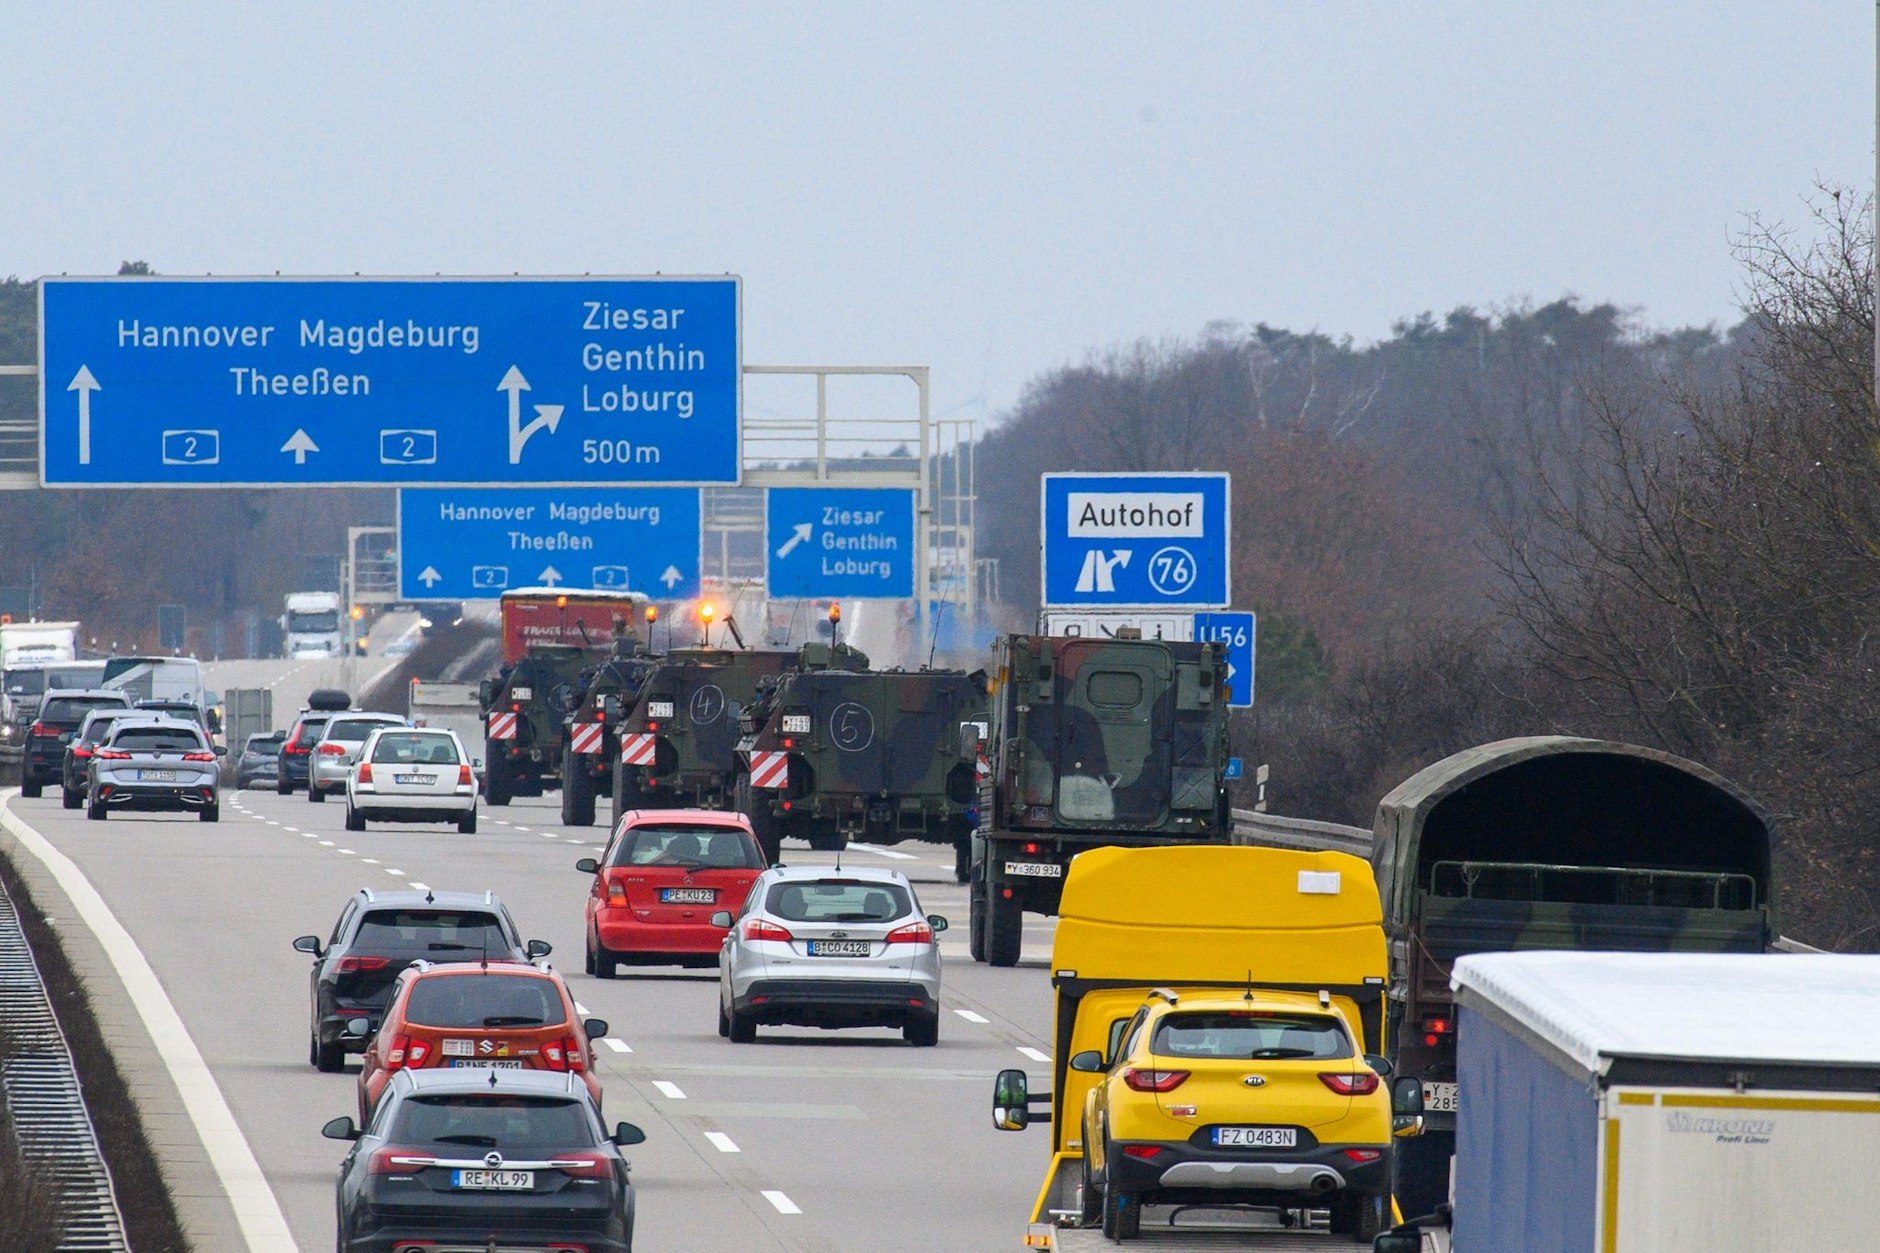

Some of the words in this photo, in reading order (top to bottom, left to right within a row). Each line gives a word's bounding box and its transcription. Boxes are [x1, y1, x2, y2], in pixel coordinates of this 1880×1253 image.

[583, 302, 684, 330] Ziesar
[118, 320, 274, 347] Hannover
[300, 320, 480, 354] Magdeburg
[583, 343, 704, 371] Genthin
[230, 367, 370, 395] Theeßen
[583, 385, 694, 418] Loburg
[184, 437, 197, 458] 2
[402, 437, 415, 458] 2
[440, 503, 534, 520] Hannover
[549, 503, 660, 525] Magdeburg
[822, 506, 884, 526] Ziesar
[1078, 502, 1194, 527] Autohof
[508, 531, 592, 550] Theeßen
[822, 531, 898, 551] Genthin
[485, 570, 494, 584] 2
[822, 557, 891, 578] Loburg
[1157, 557, 1189, 585] 76
[1221, 1129, 1242, 1144] FZ
[1246, 1129, 1293, 1145] 0483N
[1694, 1118, 1777, 1135] KRONE
[1715, 1135, 1743, 1143] Profi
